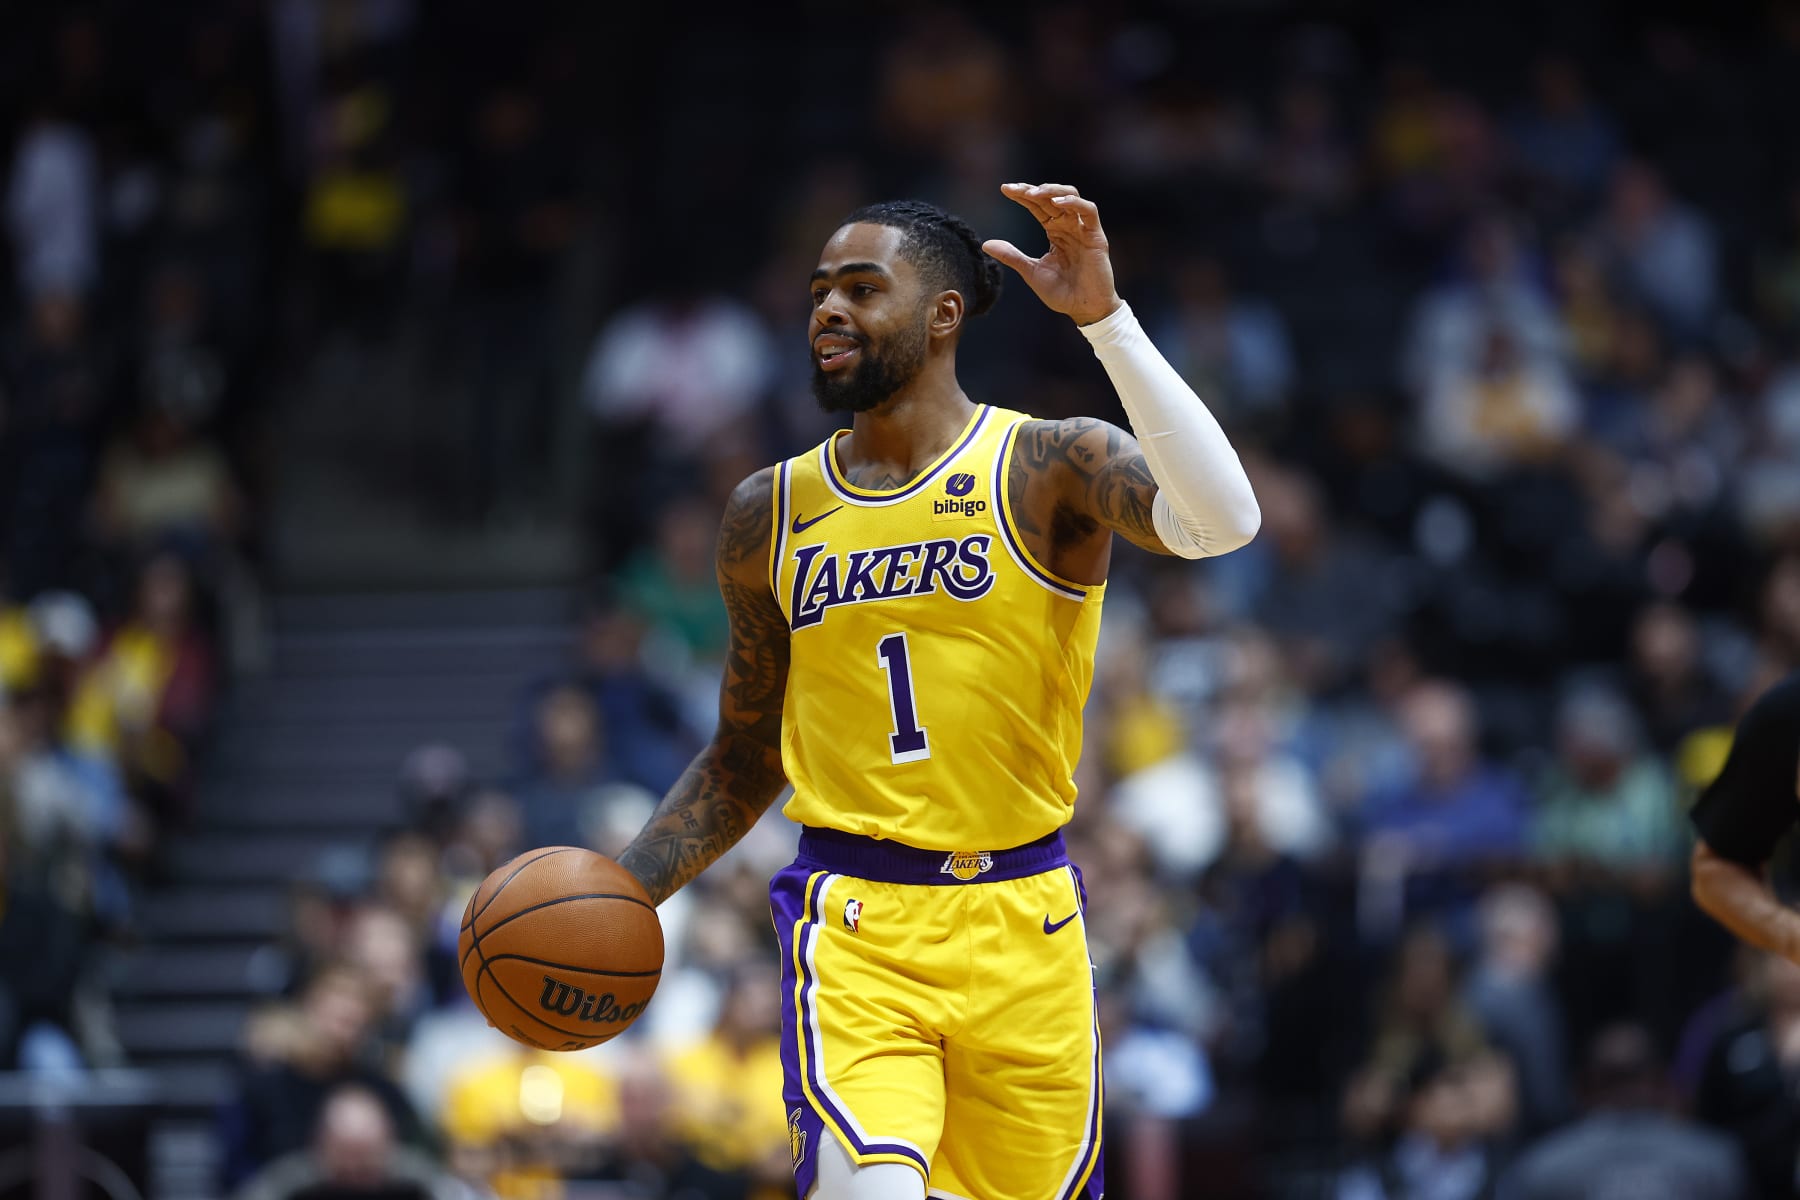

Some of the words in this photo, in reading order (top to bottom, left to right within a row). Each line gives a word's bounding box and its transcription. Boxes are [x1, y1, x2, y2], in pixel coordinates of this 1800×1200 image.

[933, 498, 986, 517] bibigo
[791, 533, 997, 632] LAKERS
[876, 631, 931, 765] 1
[940, 854, 994, 873] LAKERS
